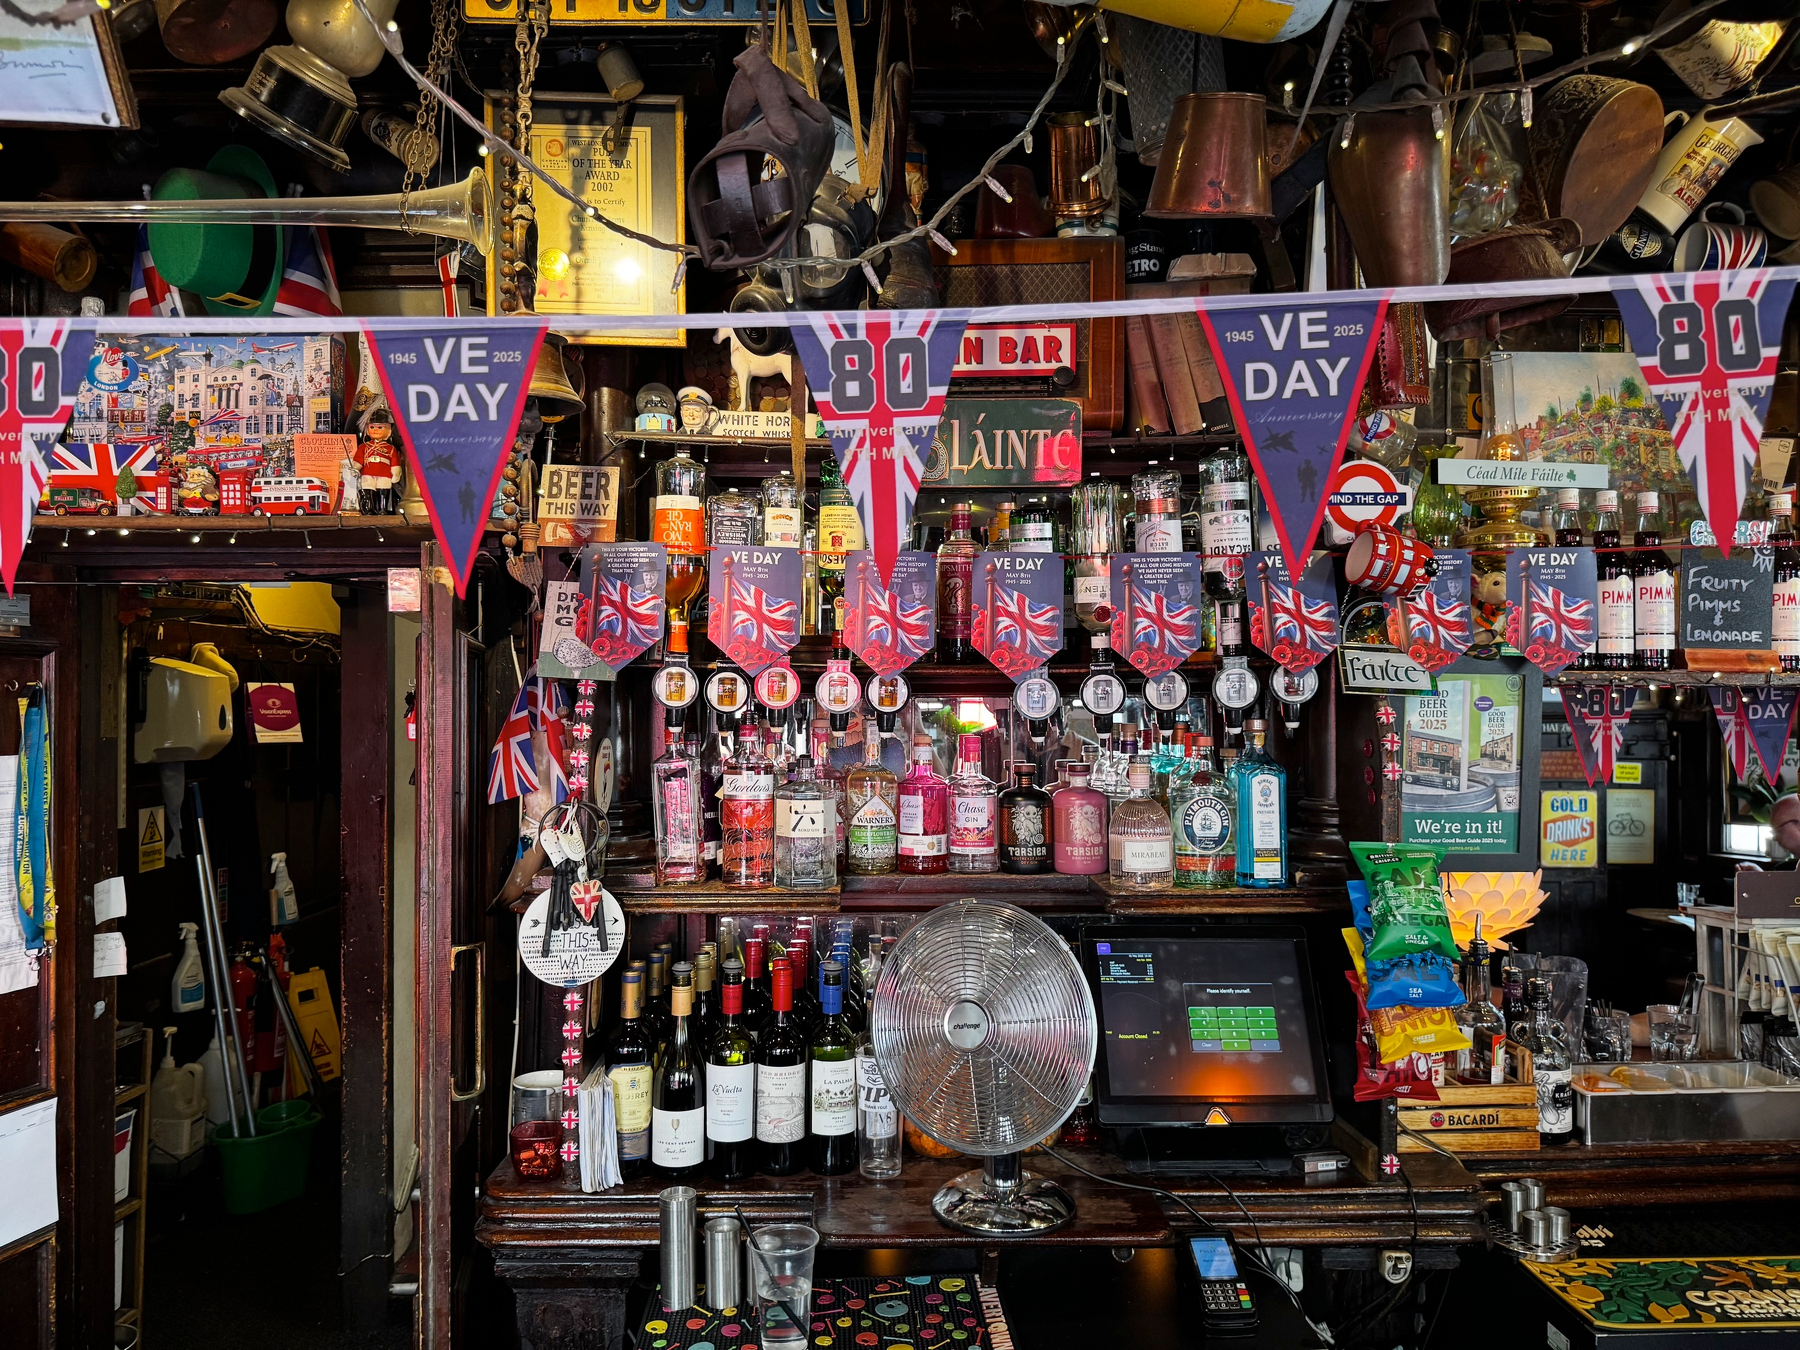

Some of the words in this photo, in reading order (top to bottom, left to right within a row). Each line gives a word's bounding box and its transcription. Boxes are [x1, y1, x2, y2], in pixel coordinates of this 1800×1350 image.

[572, 158, 584, 168] OF
[587, 159, 606, 168] THE
[607, 160, 632, 169] YEAR
[585, 171, 620, 180] AWARD
[592, 182, 614, 192] 2002
[603, 198, 626, 206] Certify
[1224, 330, 1254, 343] 1945
[1258, 310, 1330, 351] VE
[1333, 324, 1364, 337] 2025
[1658, 299, 1763, 377] 80
[106, 352, 124, 362] love
[424, 337, 489, 374] VE
[493, 352, 522, 362] 2025
[998, 336, 1063, 364] BAR
[389, 353, 417, 364] 1945
[830, 336, 930, 414] 80
[1244, 357, 1350, 401] DAY
[94, 380, 118, 390] LONDON
[1662, 384, 1766, 403] Anniversary
[408, 383, 509, 423] DAY
[719, 414, 760, 428] WHITE
[766, 416, 792, 428] HOR
[1249, 406, 1344, 425] Anniversary
[1676, 408, 1711, 424] 8TH
[1718, 405, 1756, 422] MAY
[722, 428, 755, 437] SCOTCH
[762, 430, 792, 438] WHISK
[832, 424, 931, 440] Anniversary
[844, 447, 880, 462] 8TH
[882, 444, 920, 461] MAY
[1466, 464, 1497, 480] Céad
[1500, 466, 1528, 481] Míle
[1531, 466, 1564, 482] Fáilte
[550, 471, 610, 500] BEER
[1360, 494, 1376, 504] THE
[1377, 494, 1399, 504] GAP
[546, 502, 575, 516] THIS
[580, 503, 610, 516] WAY
[667, 510, 683, 521] GIE
[670, 522, 692, 531] RAN
[664, 531, 682, 541] MO
[731, 551, 748, 564] VE
[754, 552, 782, 564] DAY
[994, 558, 1012, 570] VE
[1016, 558, 1044, 570] DAY
[1264, 556, 1282, 567] VE
[1528, 554, 1546, 565] VE
[1550, 553, 1578, 565] DAY
[1688, 565, 1754, 592] FRUITY
[1688, 593, 1740, 612] PIMMS
[1714, 612, 1723, 626] &
[1687, 623, 1762, 642] LEMONADE
[1756, 688, 1782, 700] VE
[1420, 700, 1447, 709] BEER
[1588, 688, 1625, 717] 80
[1419, 710, 1448, 718] GUIDE
[1749, 703, 1790, 719] DAY
[1419, 719, 1447, 730] 2025
[726, 777, 770, 792] Gordon's
[902, 799, 920, 809] Chase
[1550, 796, 1588, 812] COLD
[1185, 799, 1222, 826] PLYMOUTH
[1220, 809, 1228, 826] GIN
[17, 816, 25, 839] LUCKY
[1415, 820, 1461, 833] We're
[1466, 820, 1482, 833] in
[1486, 820, 1502, 833] it!
[1546, 817, 1590, 843] DRINKS
[142, 848, 162, 858] Warning
[1550, 849, 1587, 861] HERE
[561, 933, 589, 948] THIS
[559, 954, 588, 970] WAY
[712, 1084, 720, 1095] La
[721, 1084, 742, 1094] Vuelta
[858, 1087, 889, 1102] TIP
